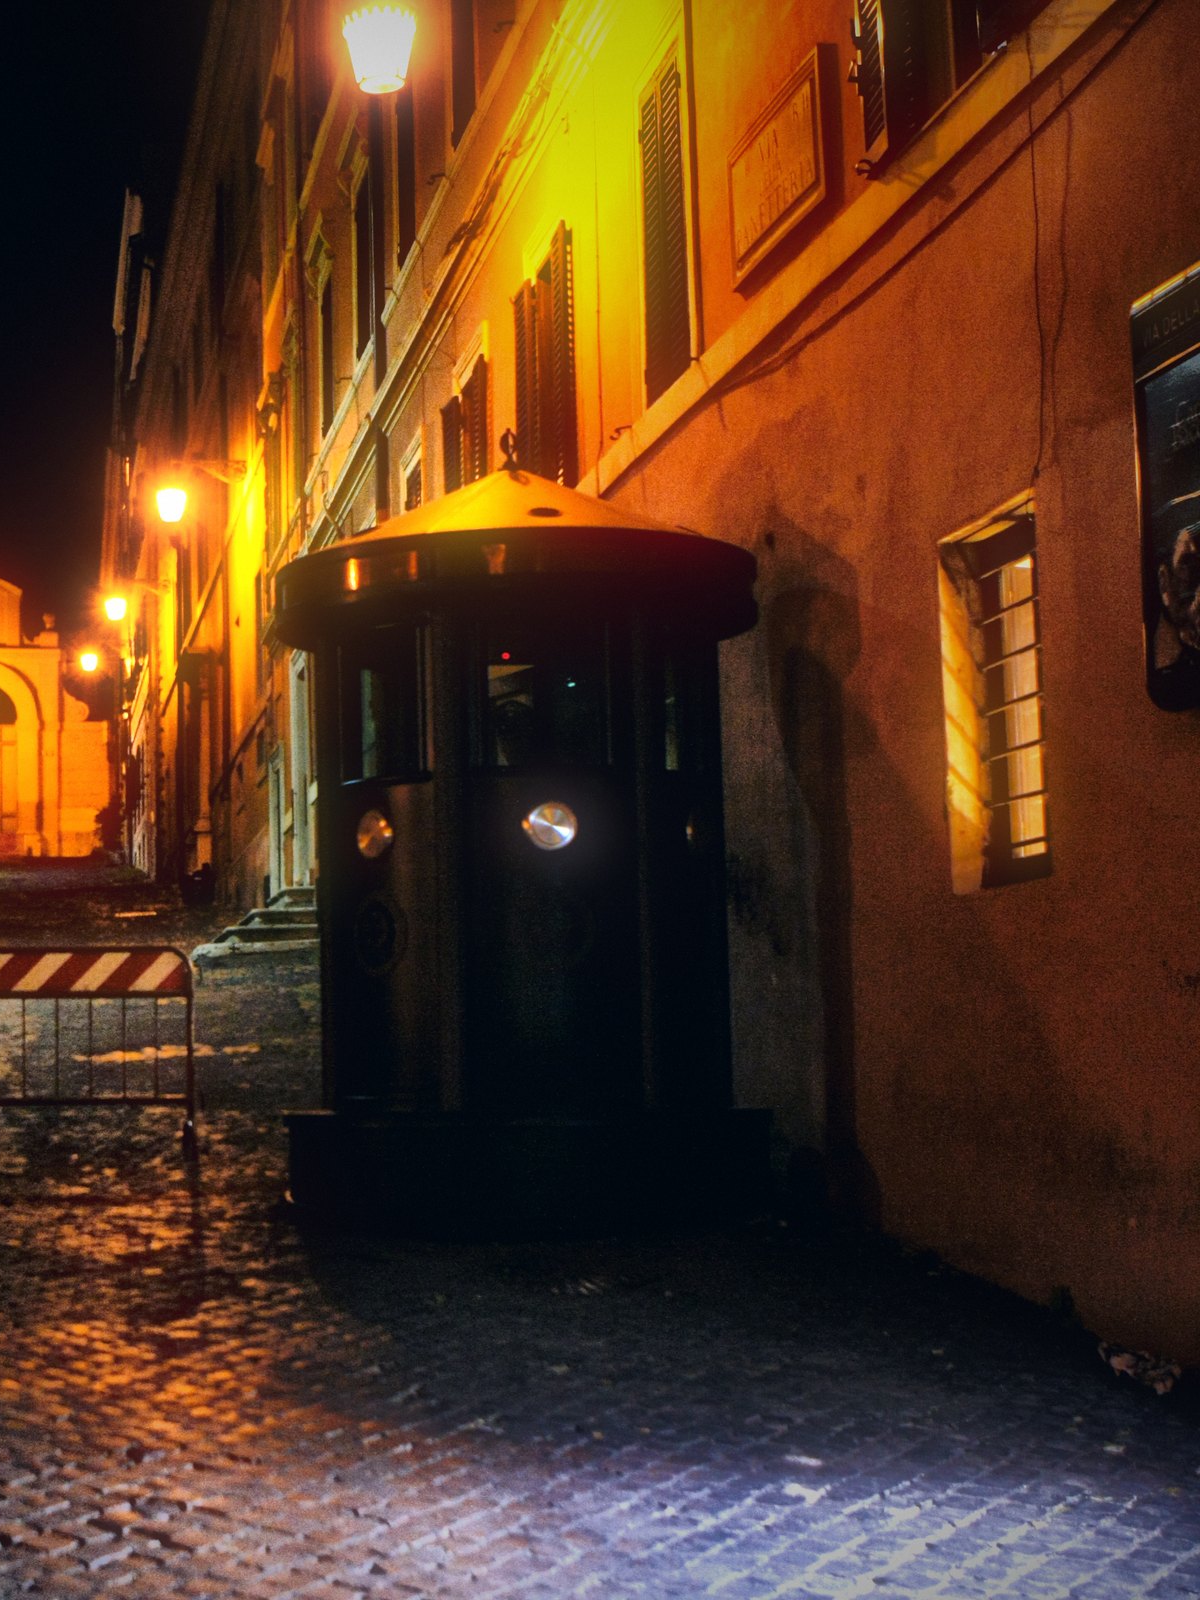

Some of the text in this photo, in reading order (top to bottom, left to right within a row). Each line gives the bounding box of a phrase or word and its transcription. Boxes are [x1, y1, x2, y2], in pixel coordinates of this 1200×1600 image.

[758, 128, 778, 161] VIA
[736, 157, 813, 257] PANETTERIA
[1143, 301, 1200, 348] VIA DELLA
